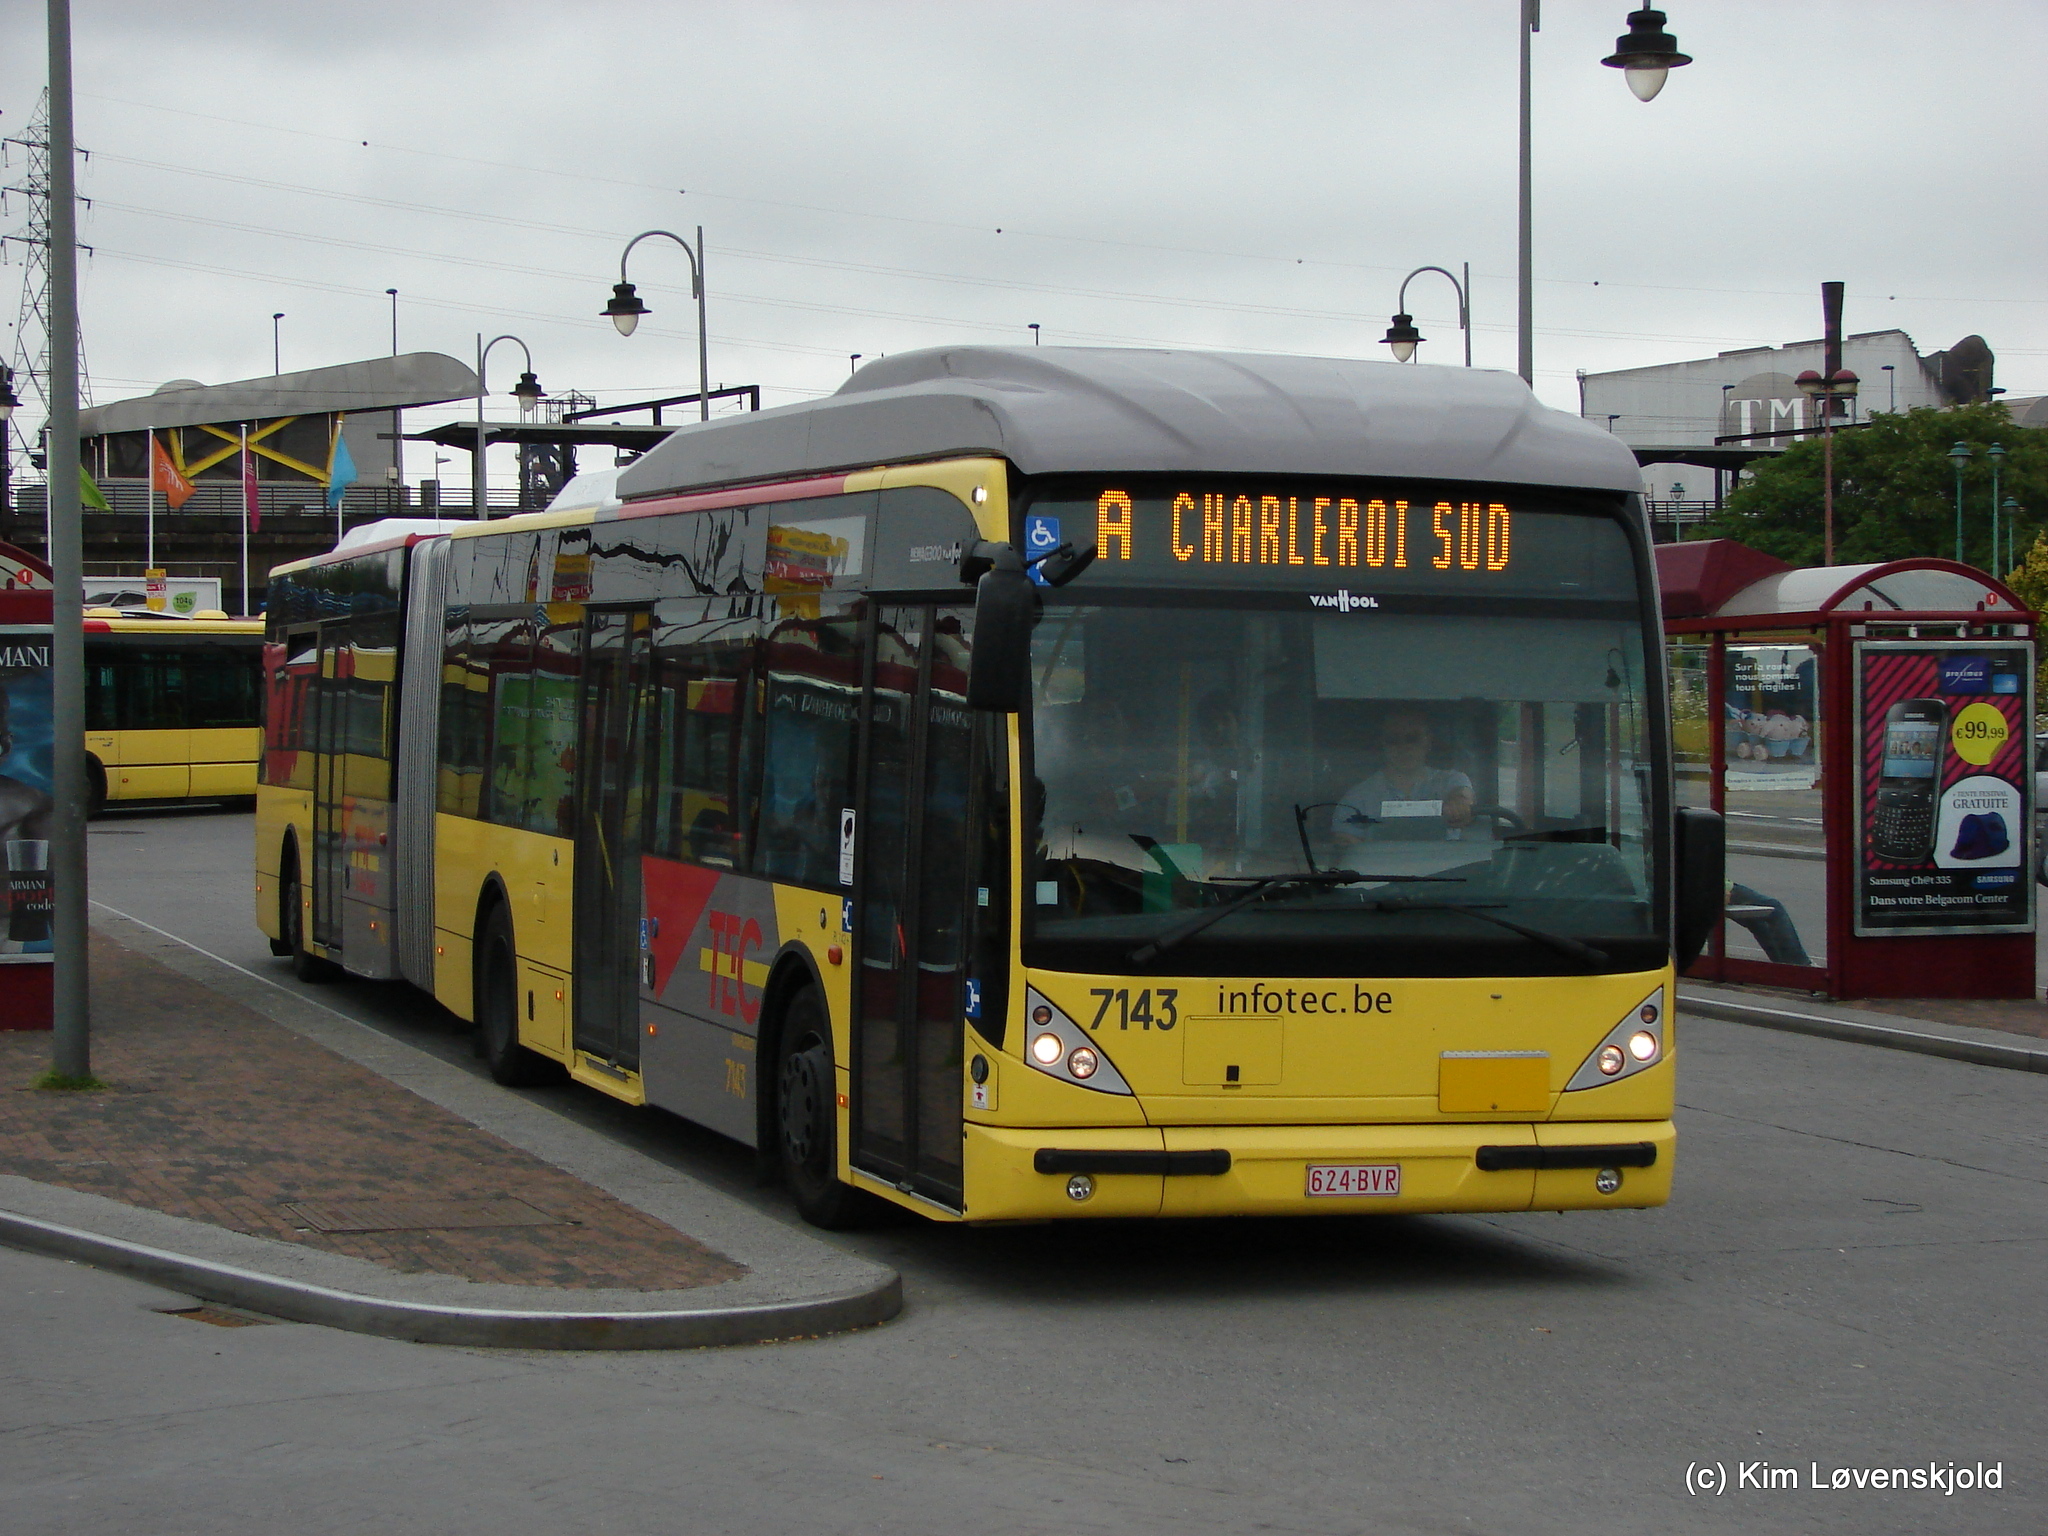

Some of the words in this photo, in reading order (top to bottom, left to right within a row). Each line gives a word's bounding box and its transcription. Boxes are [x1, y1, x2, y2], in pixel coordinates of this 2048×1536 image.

[1097, 490, 1131, 559] A
[1172, 492, 1408, 567] CHARLEROI
[1432, 502, 1510, 570] SUD
[1734, 663, 1752, 672] Sur
[1765, 662, 1792, 671] route
[1735, 673, 1757, 681] nous
[1735, 683, 1756, 691] tous
[1758, 681, 1795, 693] fragiles
[1953, 798, 2009, 809] GRATUITE
[10, 880, 46, 890] ARMANI
[1869, 876, 1910, 888] Samsung
[1935, 876, 1951, 885] 335
[1976, 875, 2015, 884] SAMSUNG
[1870, 895, 1897, 906] Dans
[1898, 896, 1924, 905] votre
[1925, 894, 1973, 907] Belgacom
[1975, 893, 2009, 904] Center
[709, 909, 763, 1026] TEC
[1090, 988, 1178, 1031] 7143
[1218, 983, 1393, 1014] infotec.be
[1311, 1169, 1397, 1192] 624-BVR
